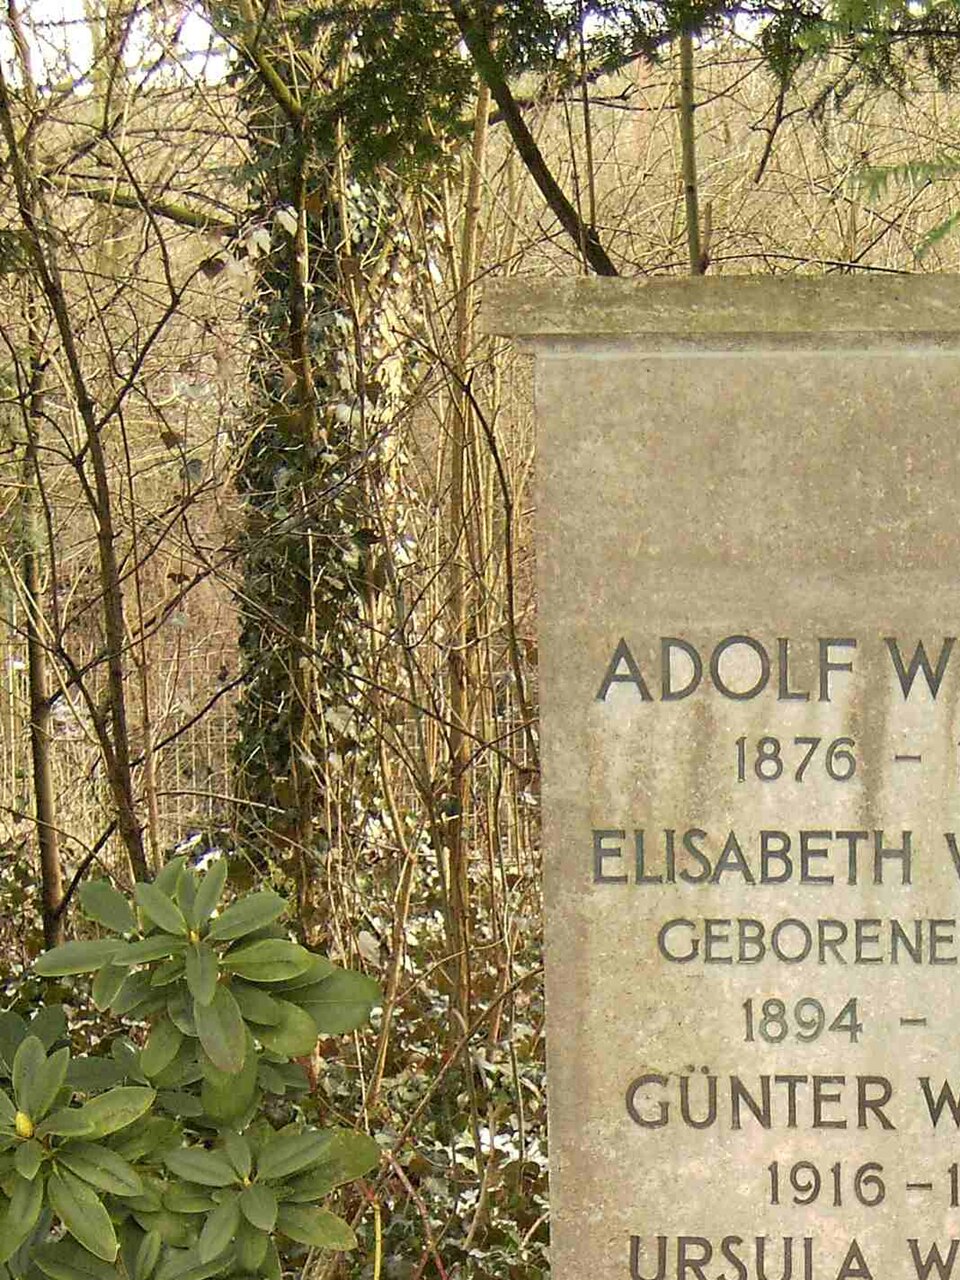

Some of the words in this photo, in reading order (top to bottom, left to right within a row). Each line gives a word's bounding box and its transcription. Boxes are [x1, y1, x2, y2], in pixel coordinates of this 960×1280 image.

[594, 634, 857, 702] ADOLF
[734, 736, 857, 783] 1876
[591, 829, 913, 886] ELISABETH
[656, 918, 958, 966] GEBORENE
[741, 997, 863, 1044] 1894
[625, 1064, 897, 1132] GÜNTER
